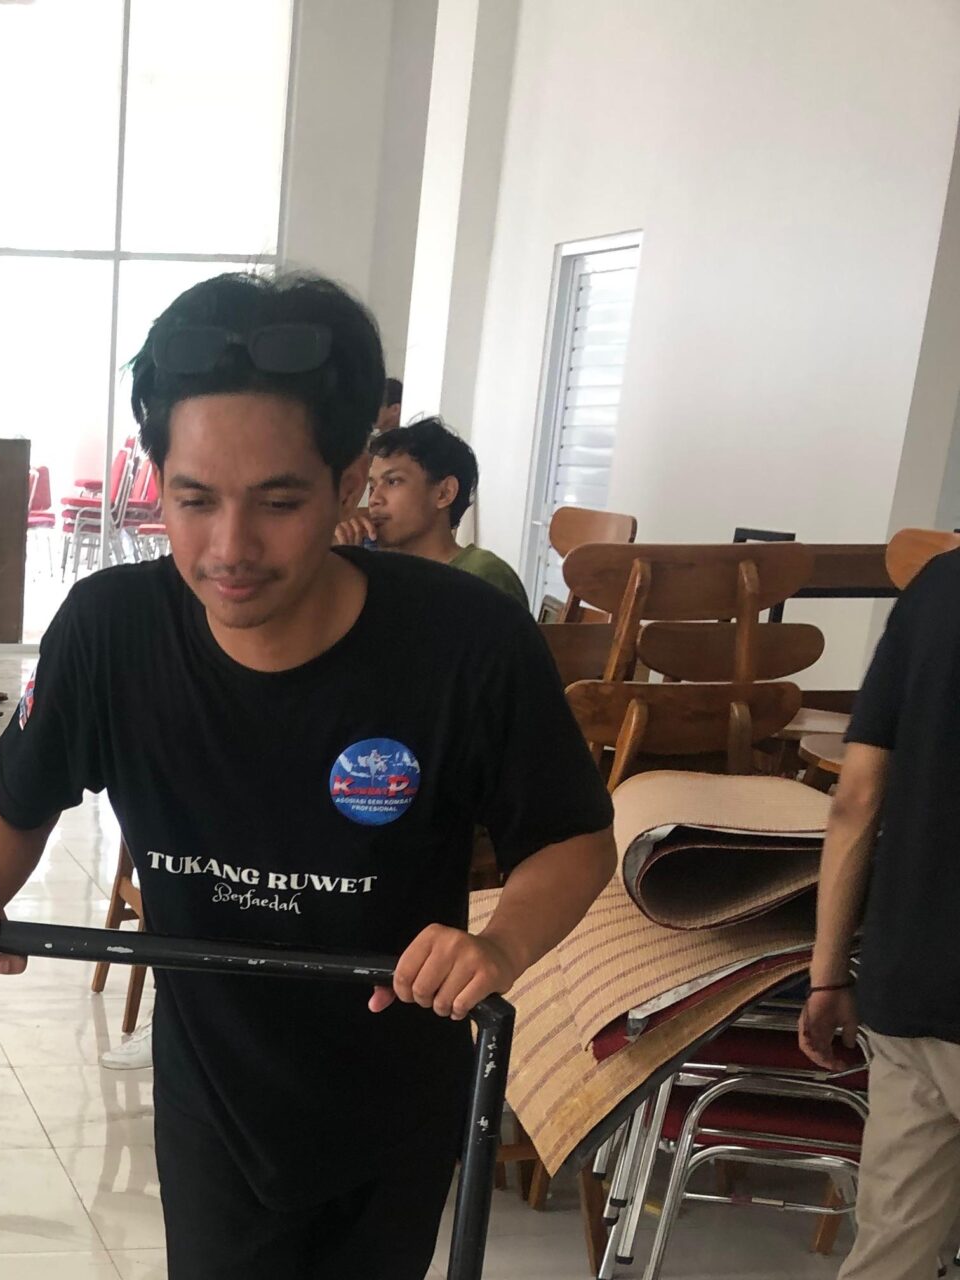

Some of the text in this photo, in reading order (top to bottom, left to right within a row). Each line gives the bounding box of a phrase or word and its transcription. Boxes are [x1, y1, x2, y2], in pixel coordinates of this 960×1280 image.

[147, 851, 377, 893] TUKANG RUWET
[212, 882, 302, 914] Berfaedah
